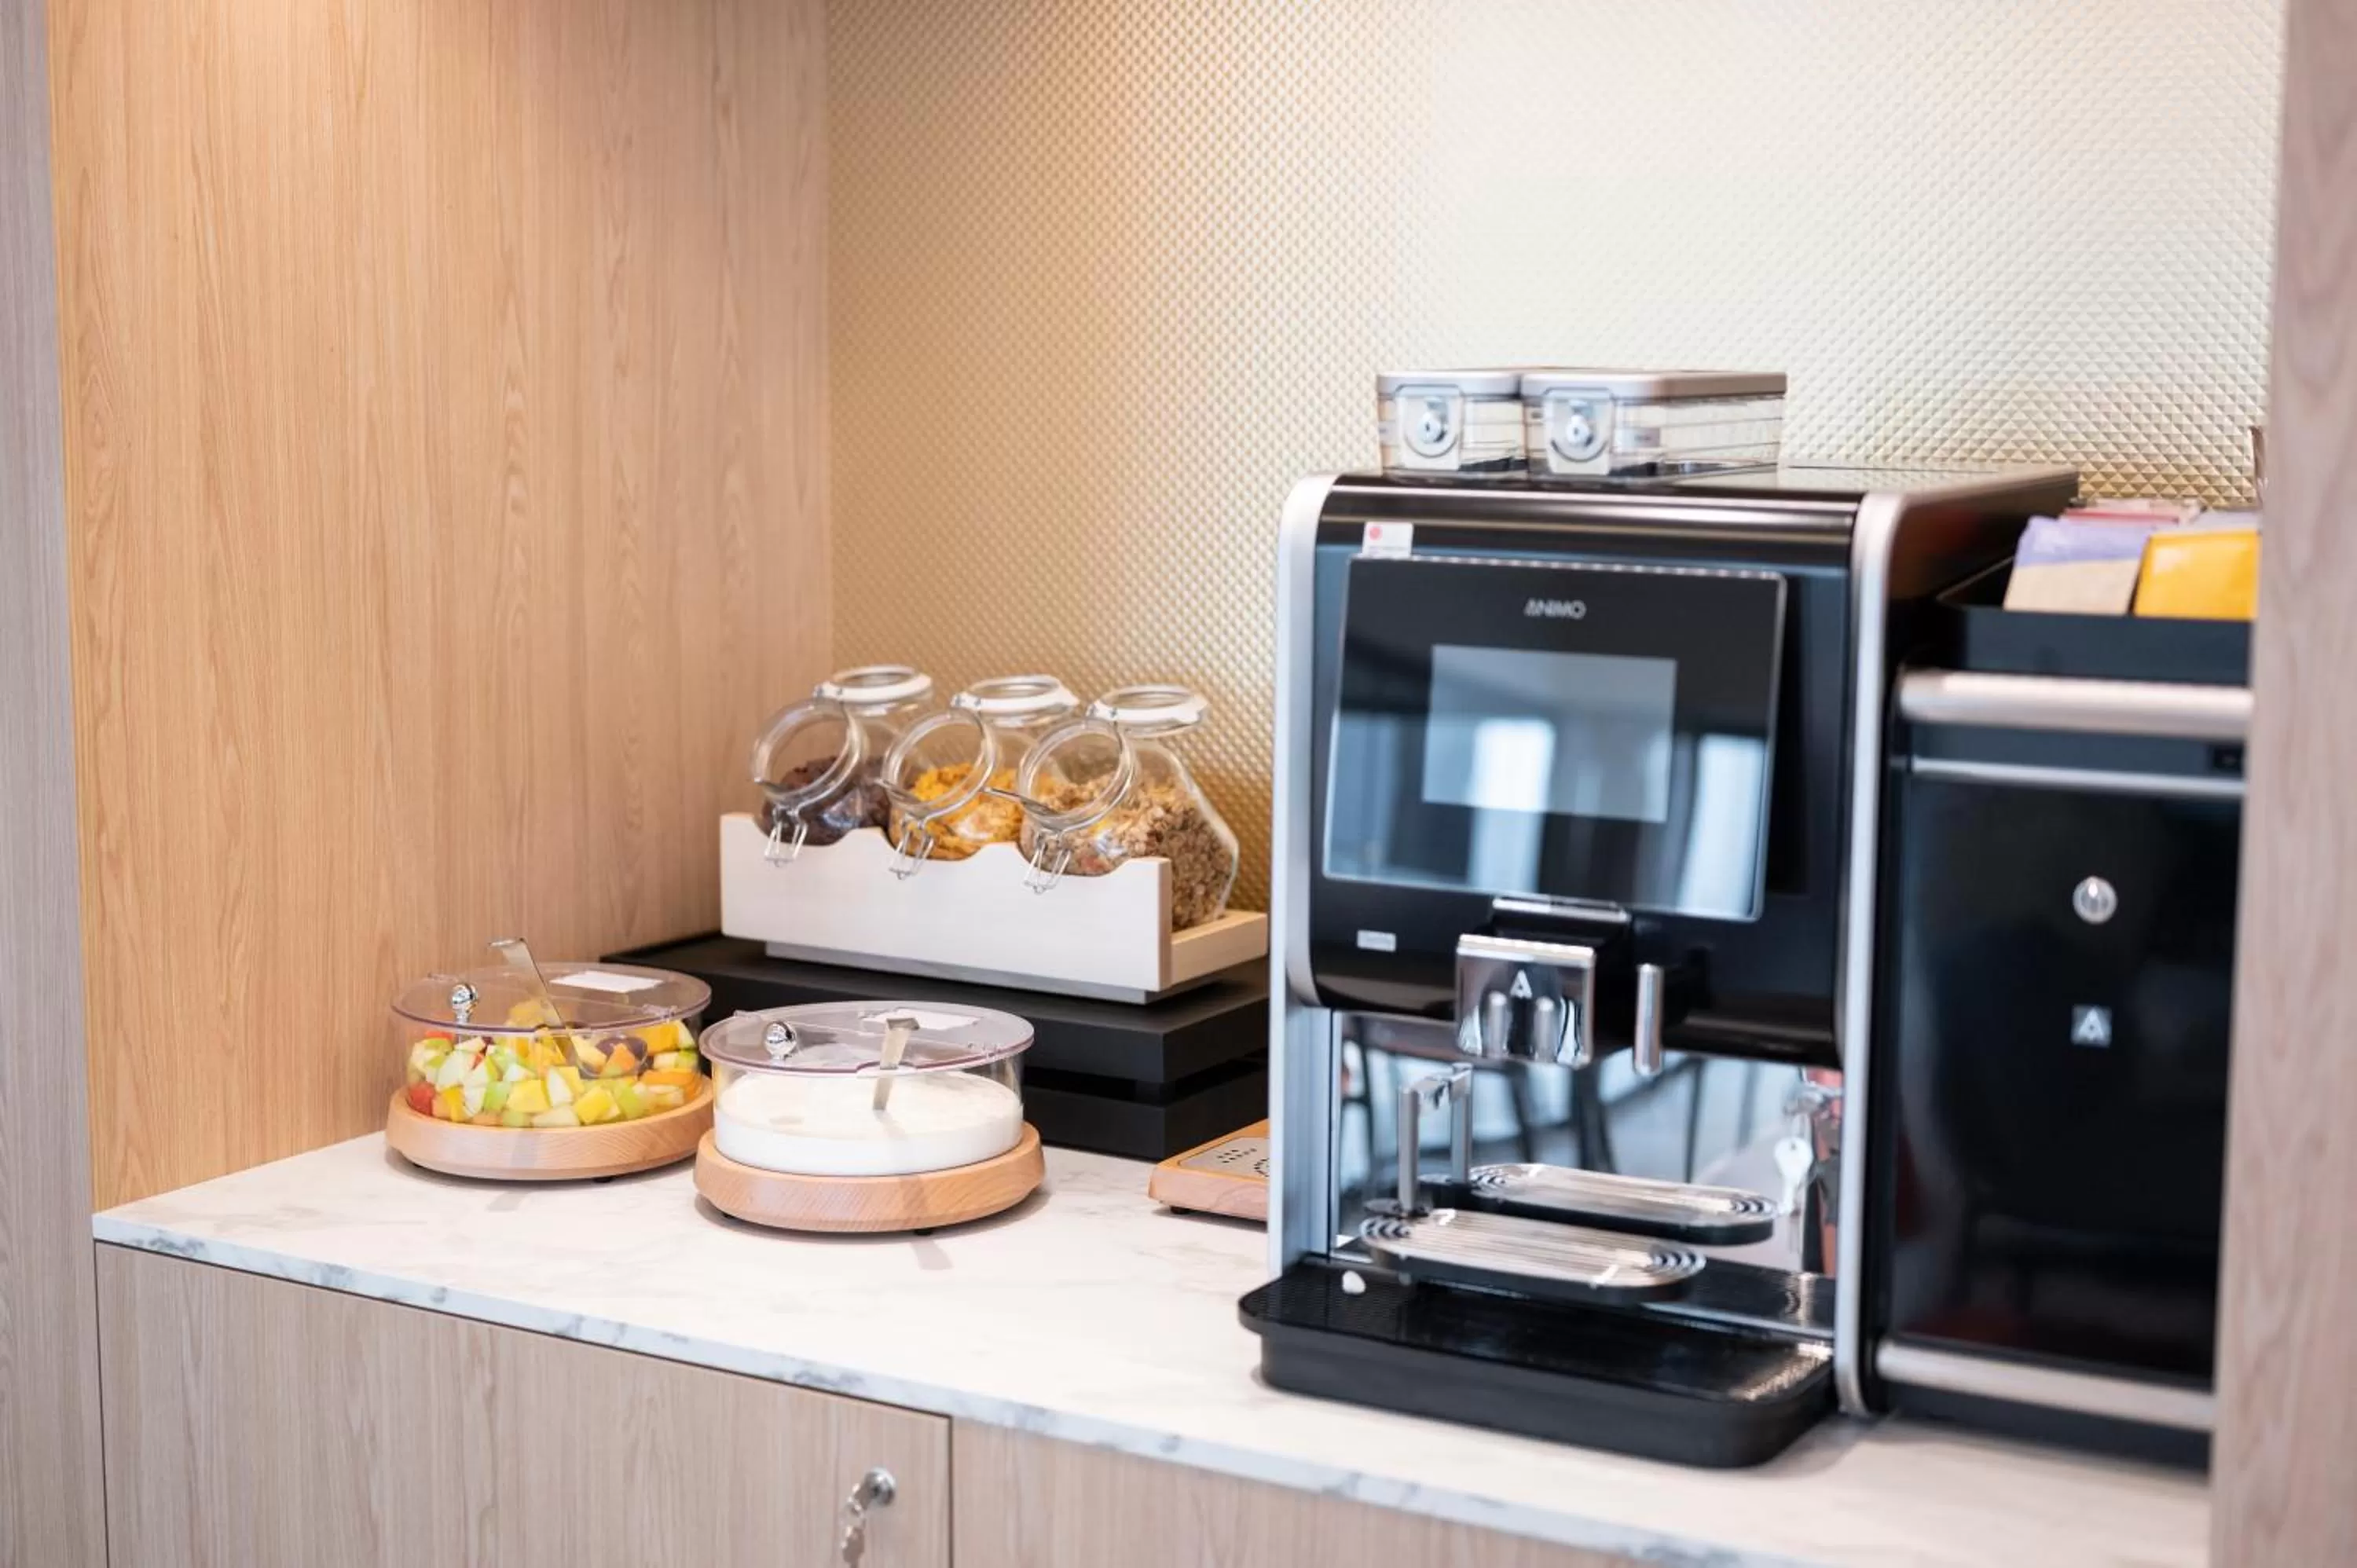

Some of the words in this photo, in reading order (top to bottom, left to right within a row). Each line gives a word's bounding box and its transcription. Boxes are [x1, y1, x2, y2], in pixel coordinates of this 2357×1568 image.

[1523, 598, 1587, 619] ANIMO
[1510, 969, 1533, 998] A
[2077, 1007, 2105, 1040] A
